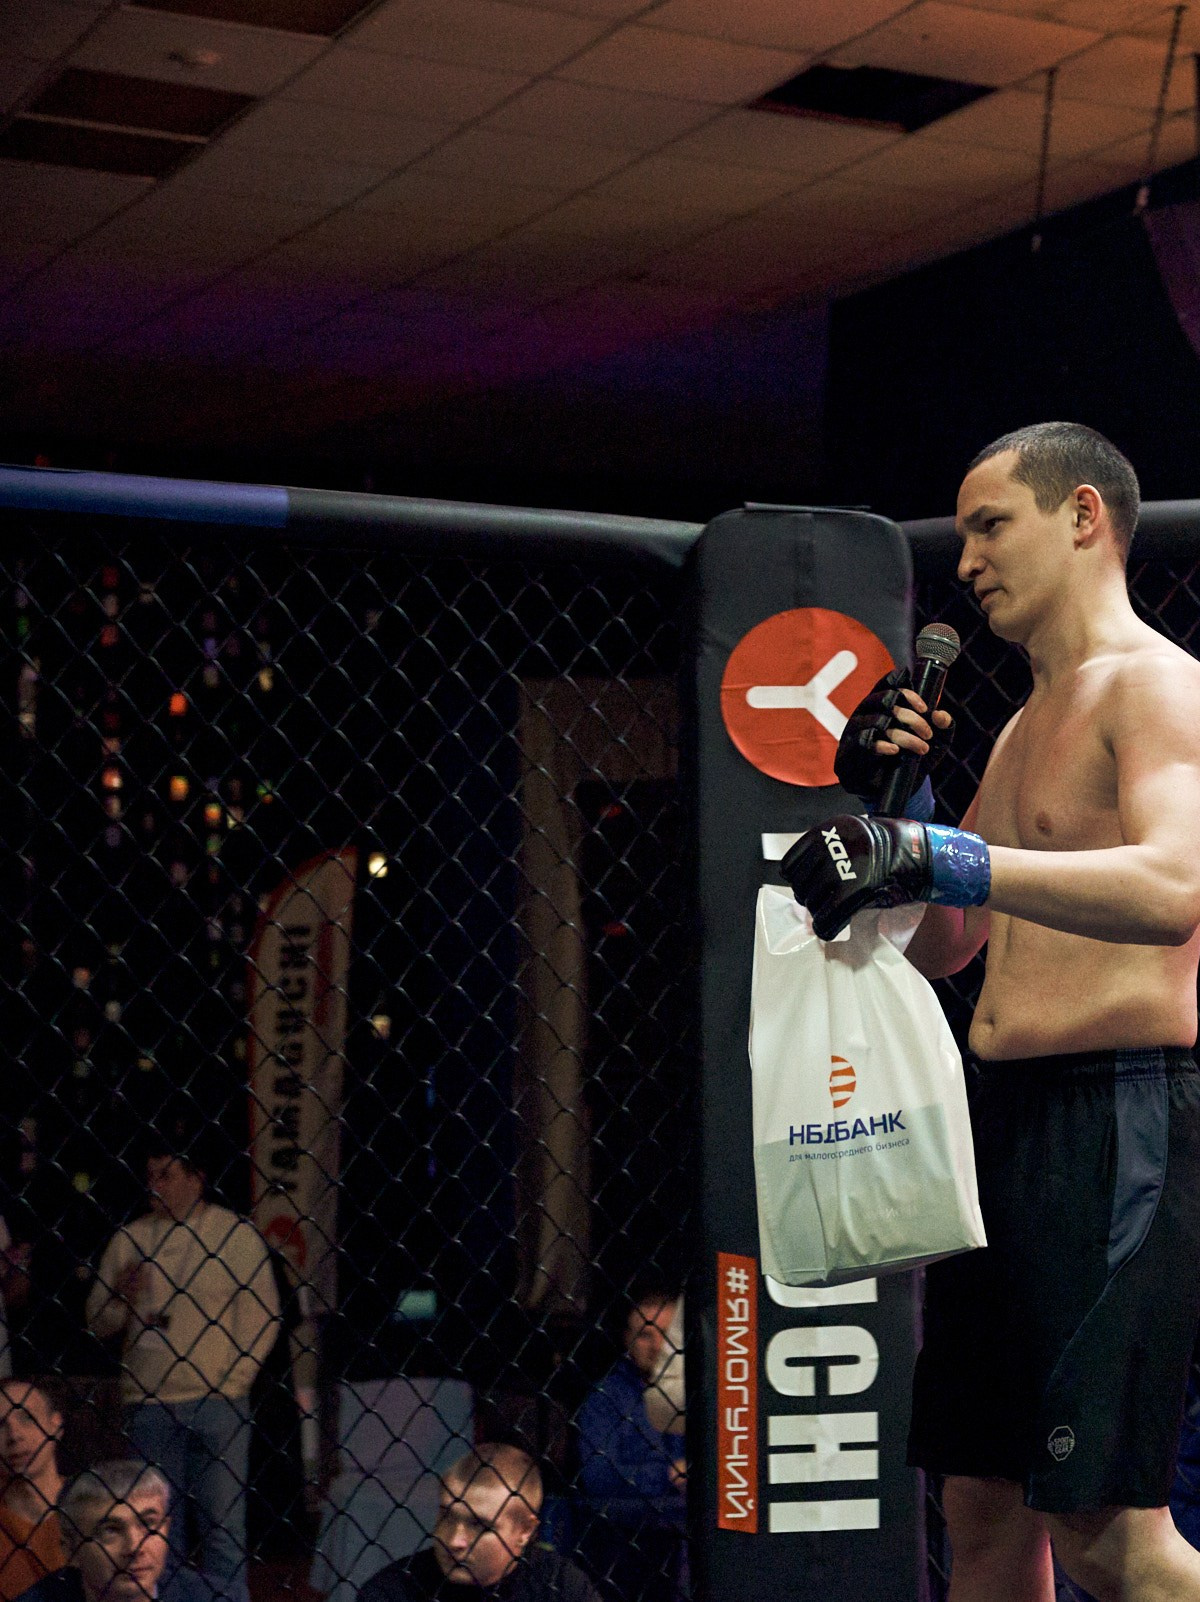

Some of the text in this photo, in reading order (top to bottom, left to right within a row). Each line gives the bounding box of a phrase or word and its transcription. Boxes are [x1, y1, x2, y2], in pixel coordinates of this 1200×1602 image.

[821, 826, 858, 881] RDX
[875, 1138, 910, 1152] бизнеса
[725, 1266, 754, 1520] #ЯМОГУЧИЙ
